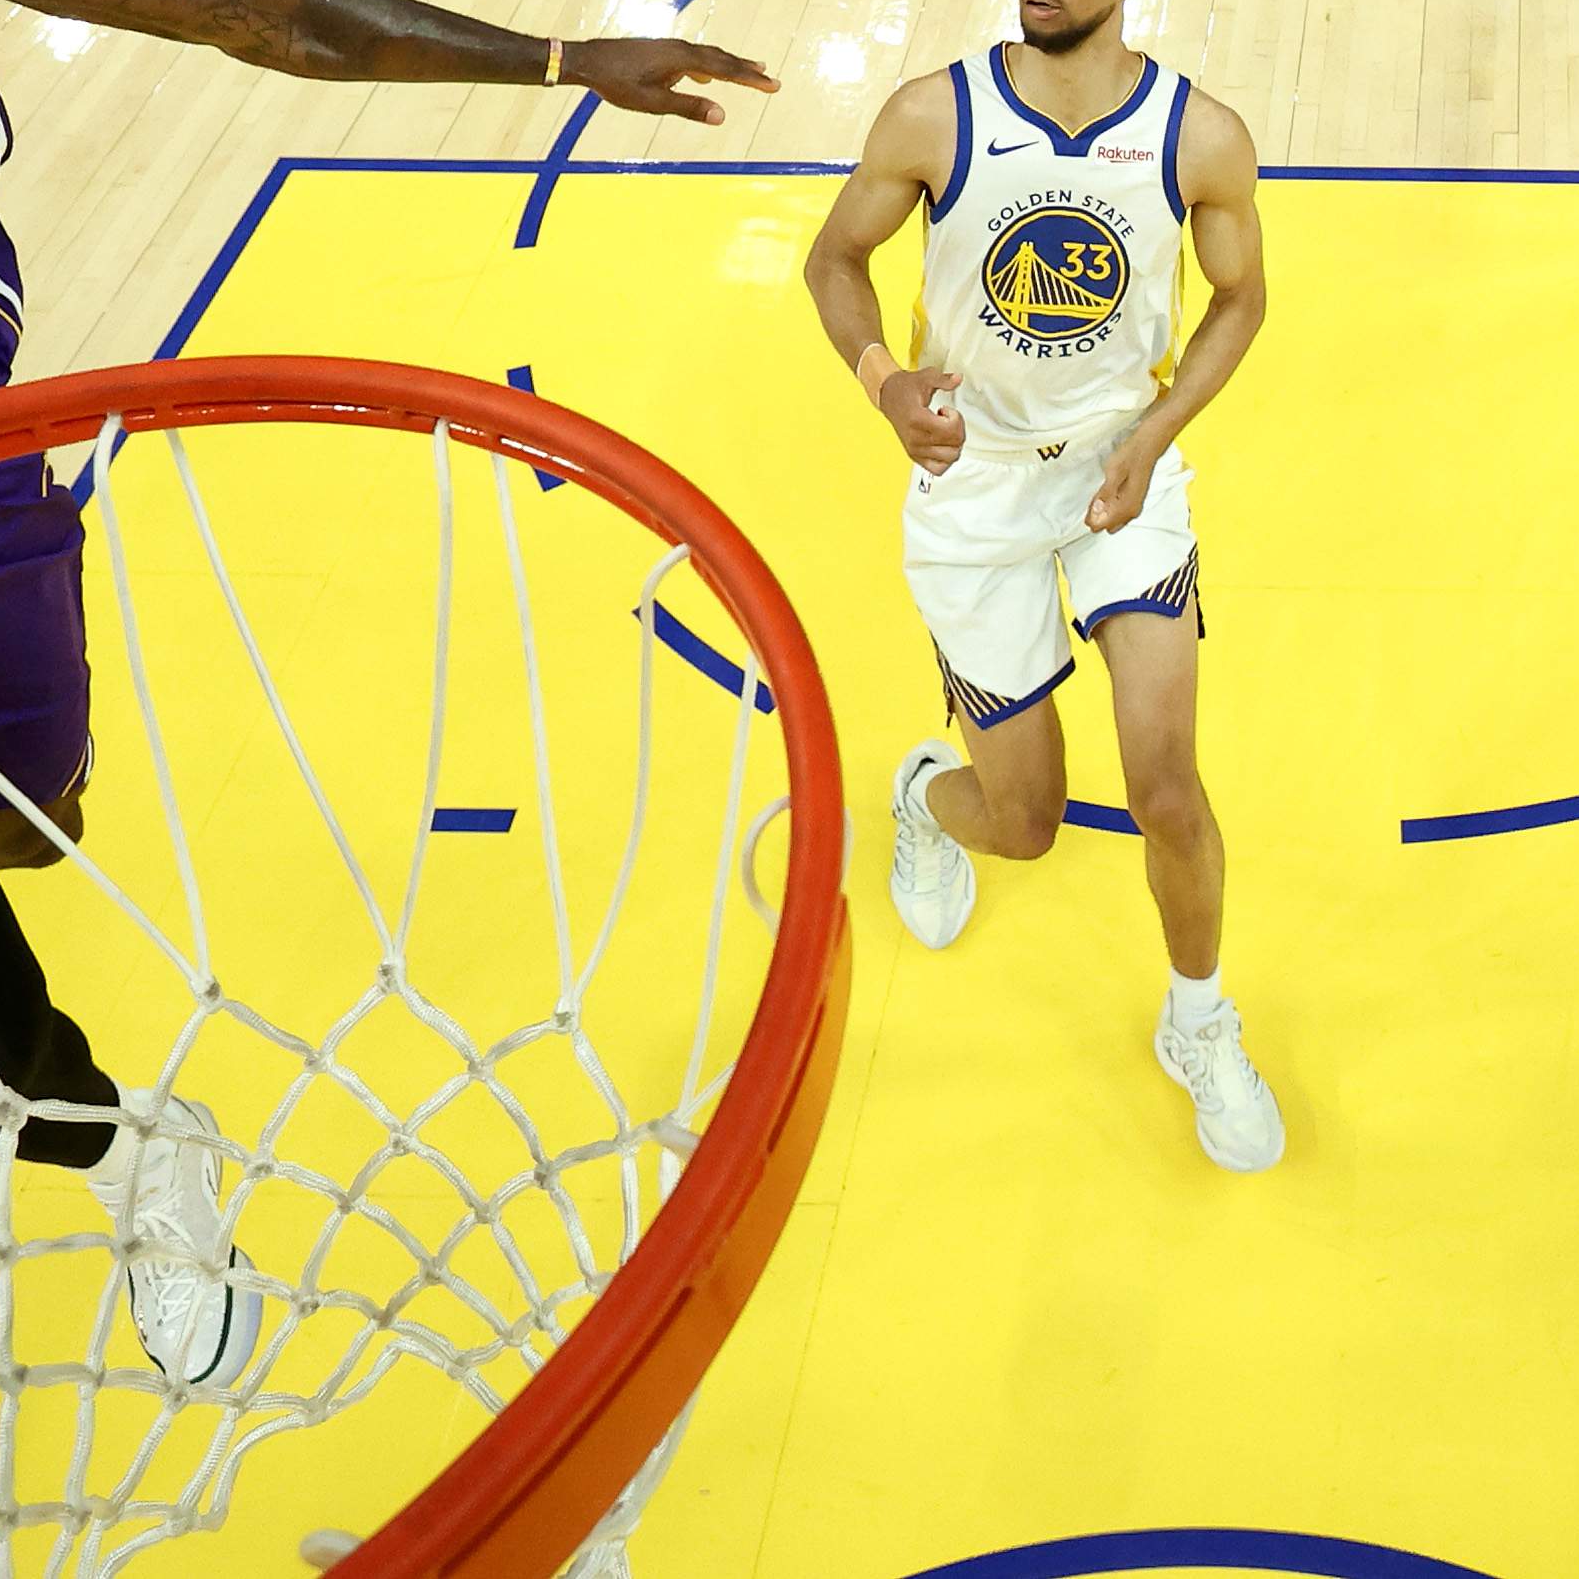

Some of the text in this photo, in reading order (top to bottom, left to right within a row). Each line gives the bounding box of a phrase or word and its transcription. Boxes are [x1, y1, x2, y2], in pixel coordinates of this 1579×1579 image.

[1097, 146, 1155, 163] Rakuten
[987, 190, 1135, 238] GOLDEN STATE
[1059, 241, 1114, 281] 33
[978, 305, 1123, 359] WARRIORS
